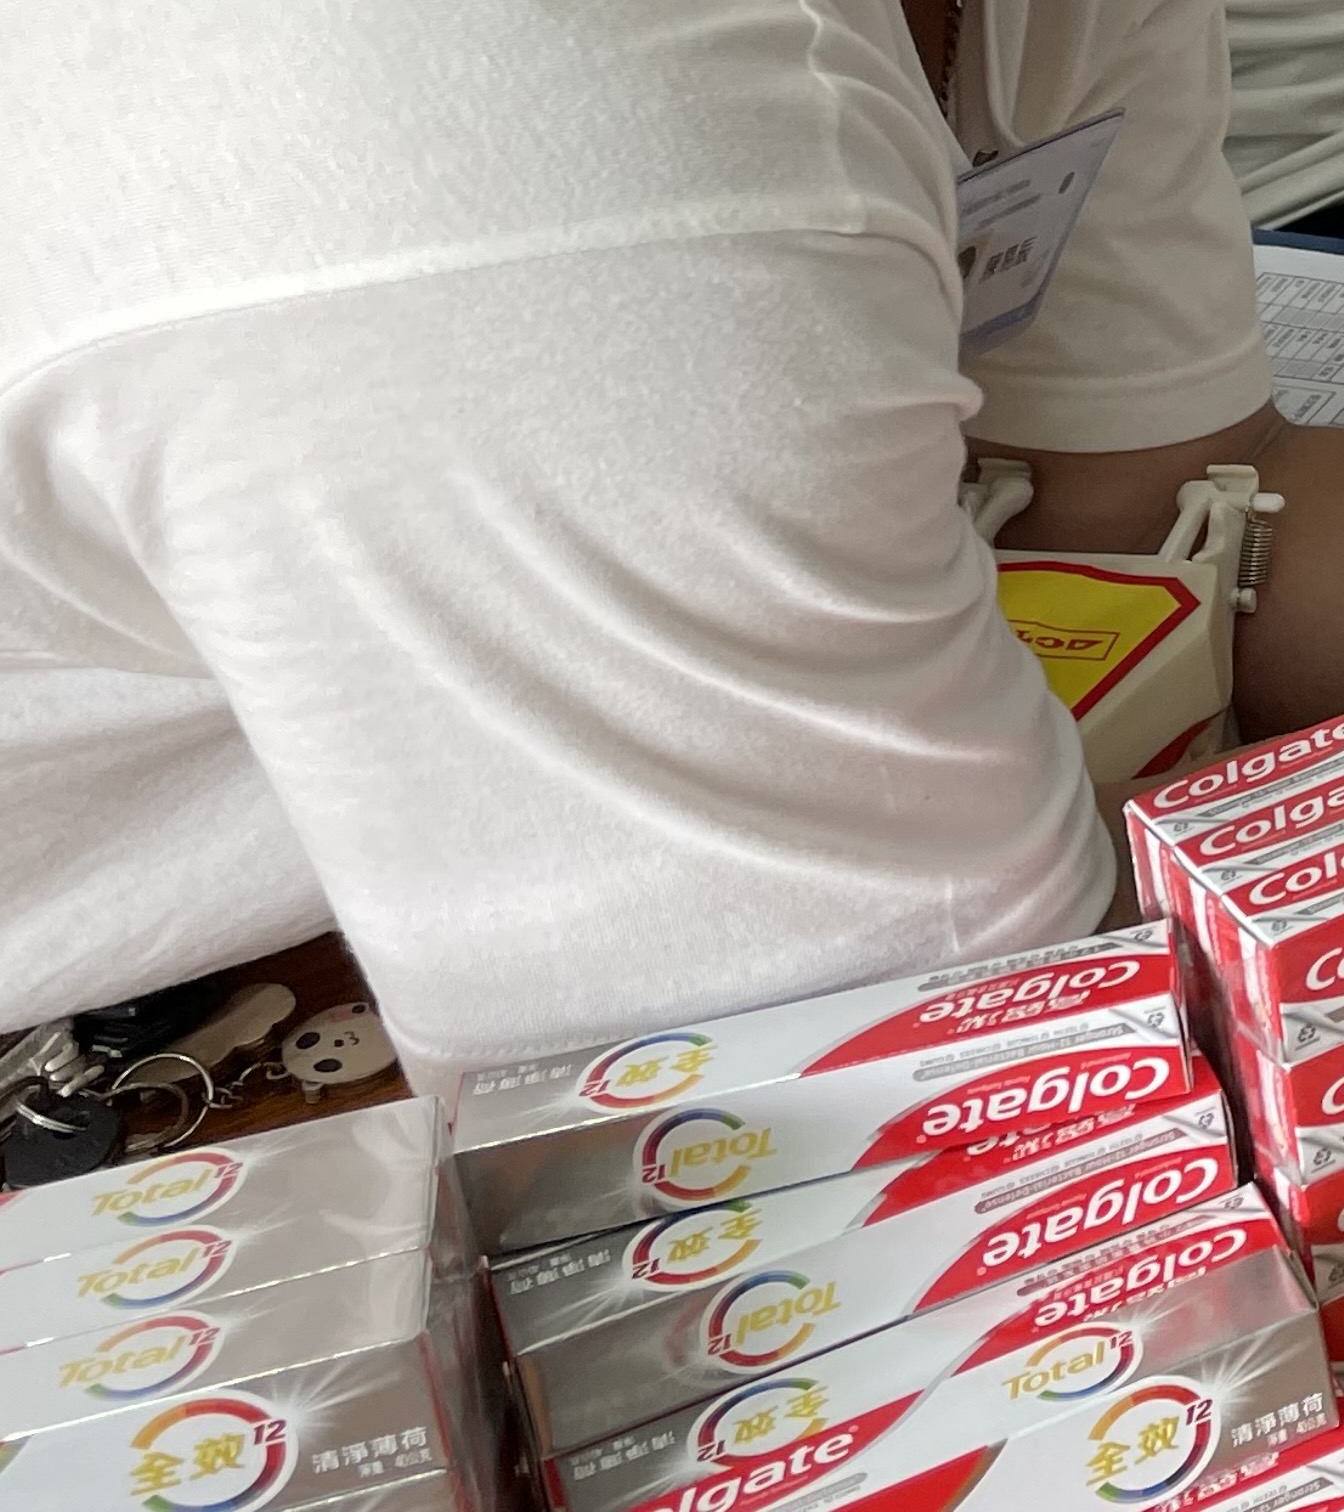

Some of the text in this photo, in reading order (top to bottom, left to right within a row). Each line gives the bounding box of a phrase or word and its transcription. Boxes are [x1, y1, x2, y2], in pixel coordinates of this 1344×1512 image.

[918, 959, 1142, 1026] Colgate
[920, 1056, 1171, 1139] Colgate
[90, 1161, 243, 1217] Total 12
[641, 1126, 779, 1185] Total 12
[980, 1156, 1220, 1269] Colgate
[75, 1239, 232, 1299] Total 12
[1032, 1227, 1248, 1328] Colgate
[706, 1280, 843, 1357] Total 12
[58, 1326, 220, 1388] Total 12
[1001, 1330, 1134, 1401] Total 12
[311, 1425, 429, 1476] 清淨薄荷
[1084, 1415, 1181, 1488] 全效
[1185, 1396, 1213, 1428] 12
[1230, 1393, 1325, 1449] 清淨薄荷
[129, 1418, 288, 1497] 全效 12
